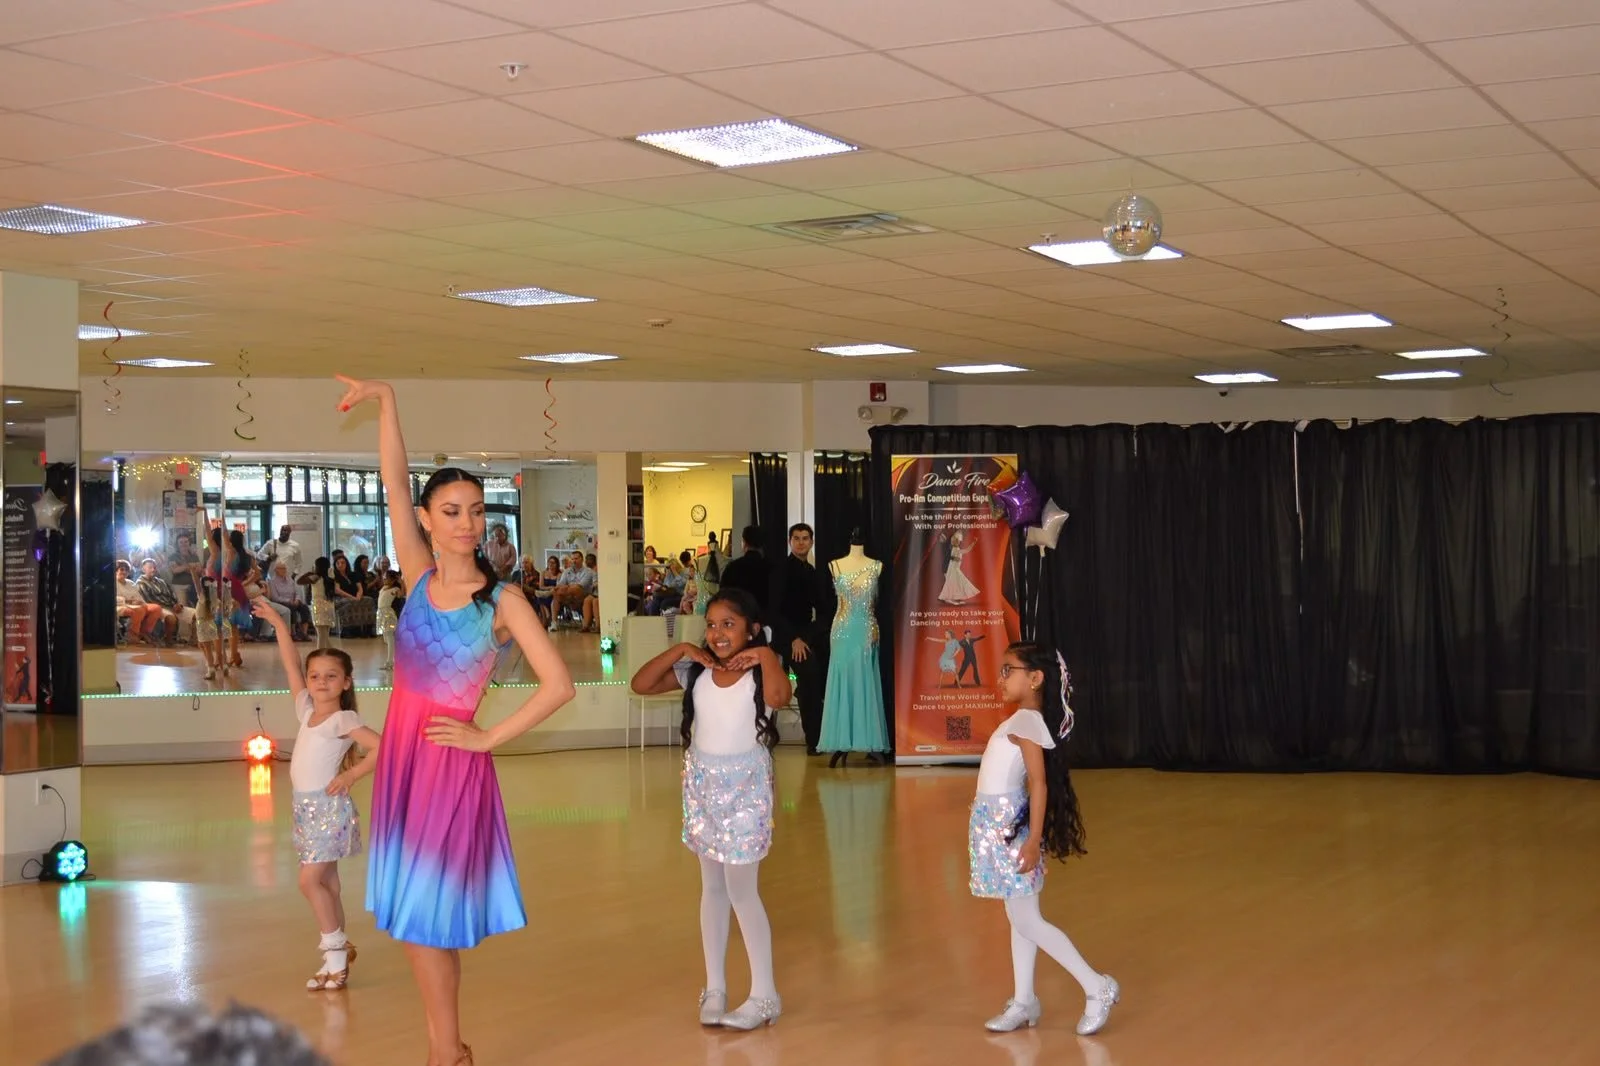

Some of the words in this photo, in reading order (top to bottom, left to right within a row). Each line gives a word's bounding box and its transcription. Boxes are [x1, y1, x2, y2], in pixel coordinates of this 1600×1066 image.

[918, 472, 961, 489] Dance
[964, 471, 990, 488] Fire
[899, 494, 926, 503] Pro-Am
[927, 493, 971, 504] Competition
[939, 610, 959, 618] ready
